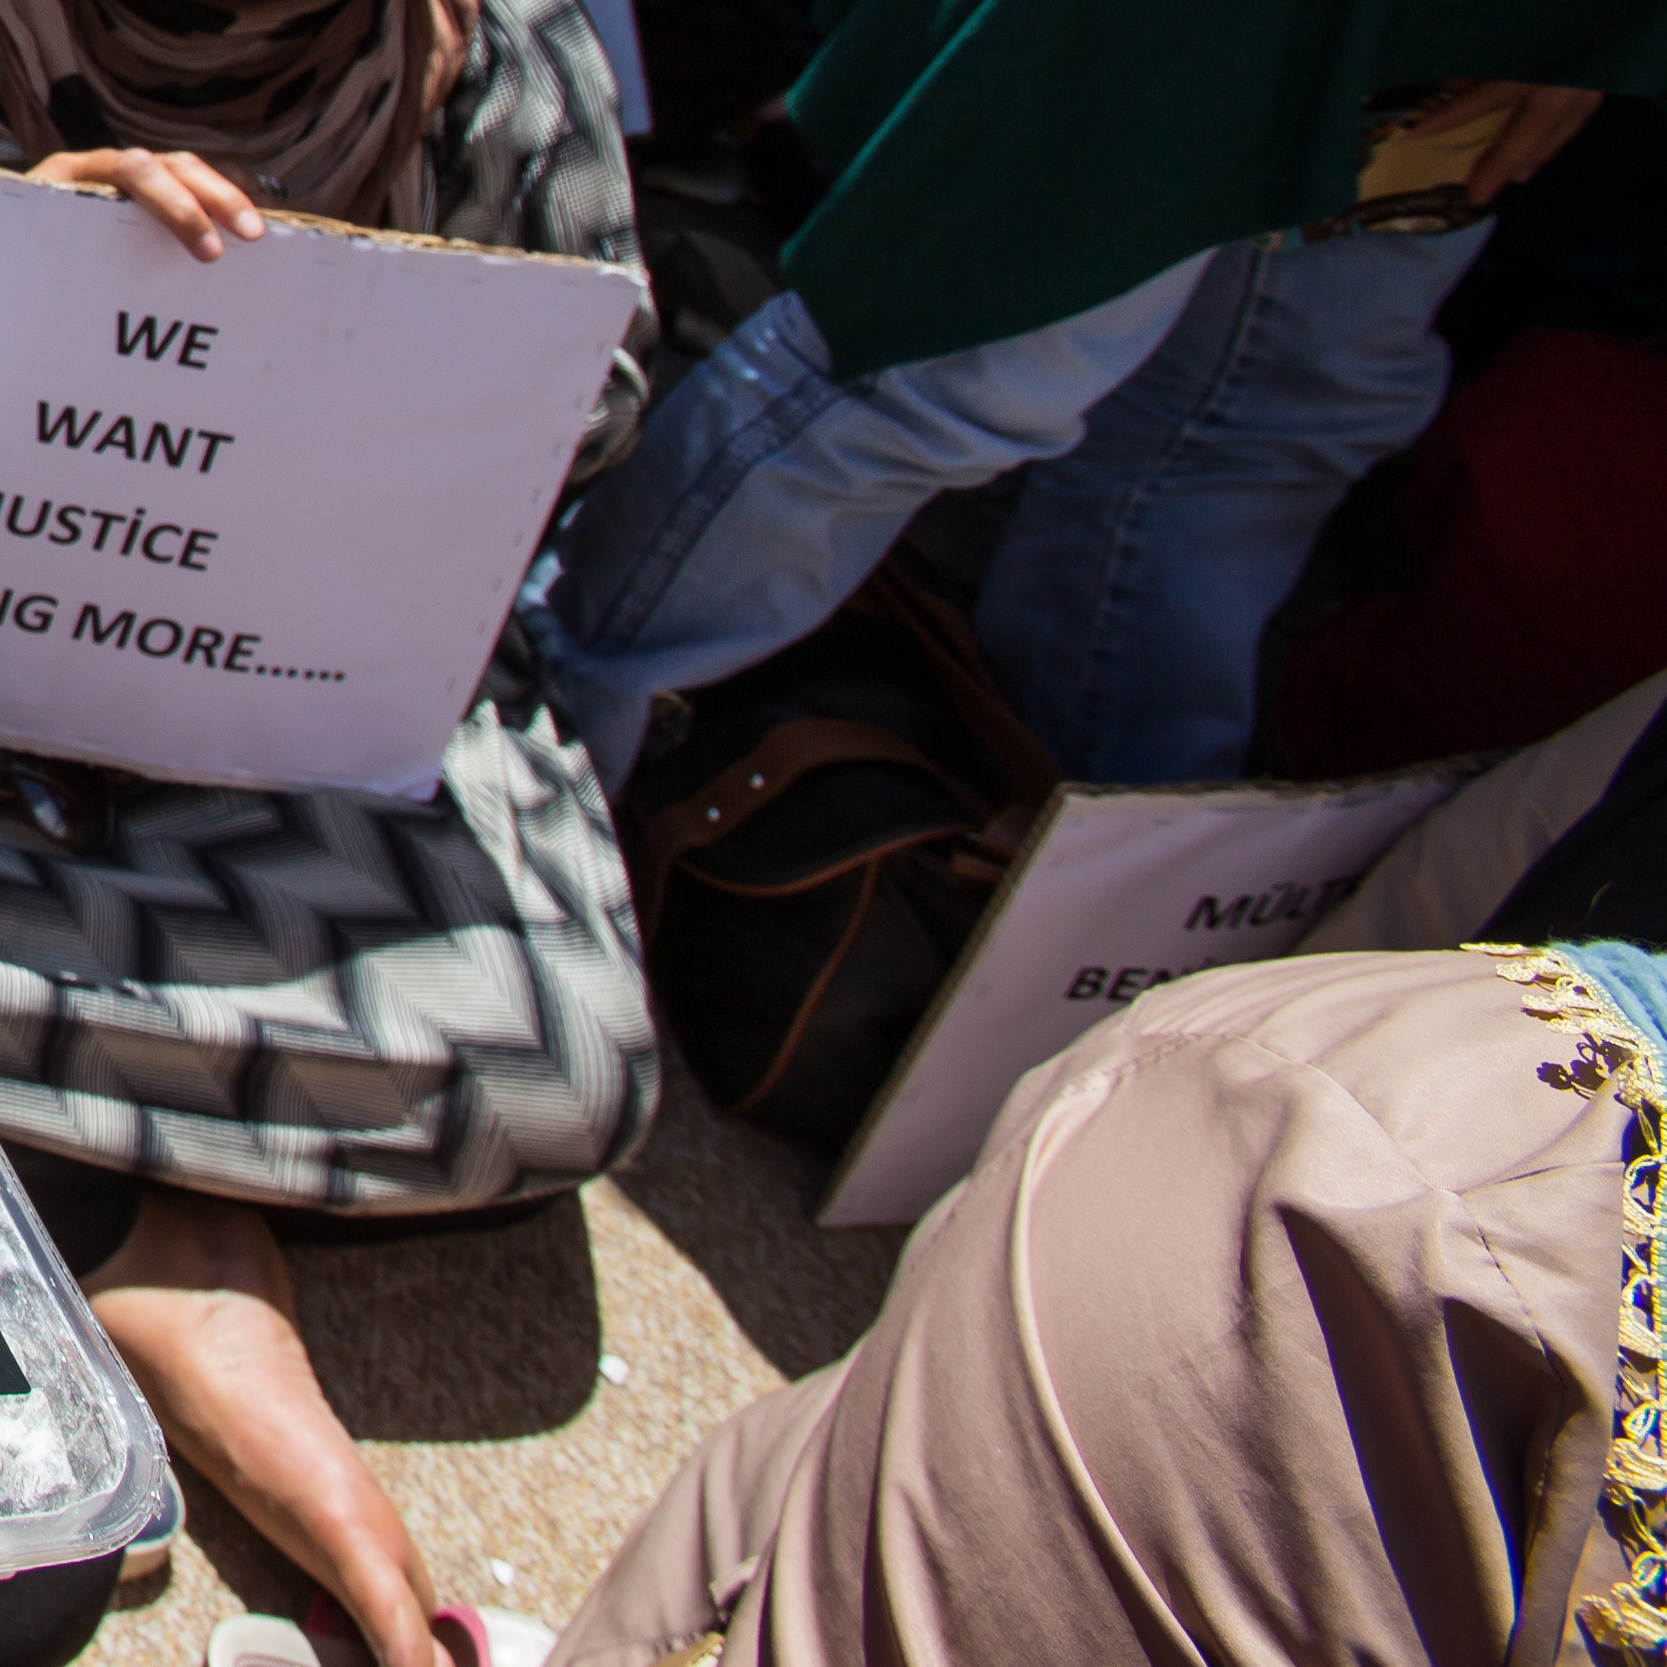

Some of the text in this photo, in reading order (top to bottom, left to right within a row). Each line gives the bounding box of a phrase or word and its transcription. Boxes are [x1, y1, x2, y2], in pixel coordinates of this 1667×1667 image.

[115, 310, 218, 371] WE
[35, 402, 235, 475] WANT
[1184, 880, 1361, 931] MÜLT
